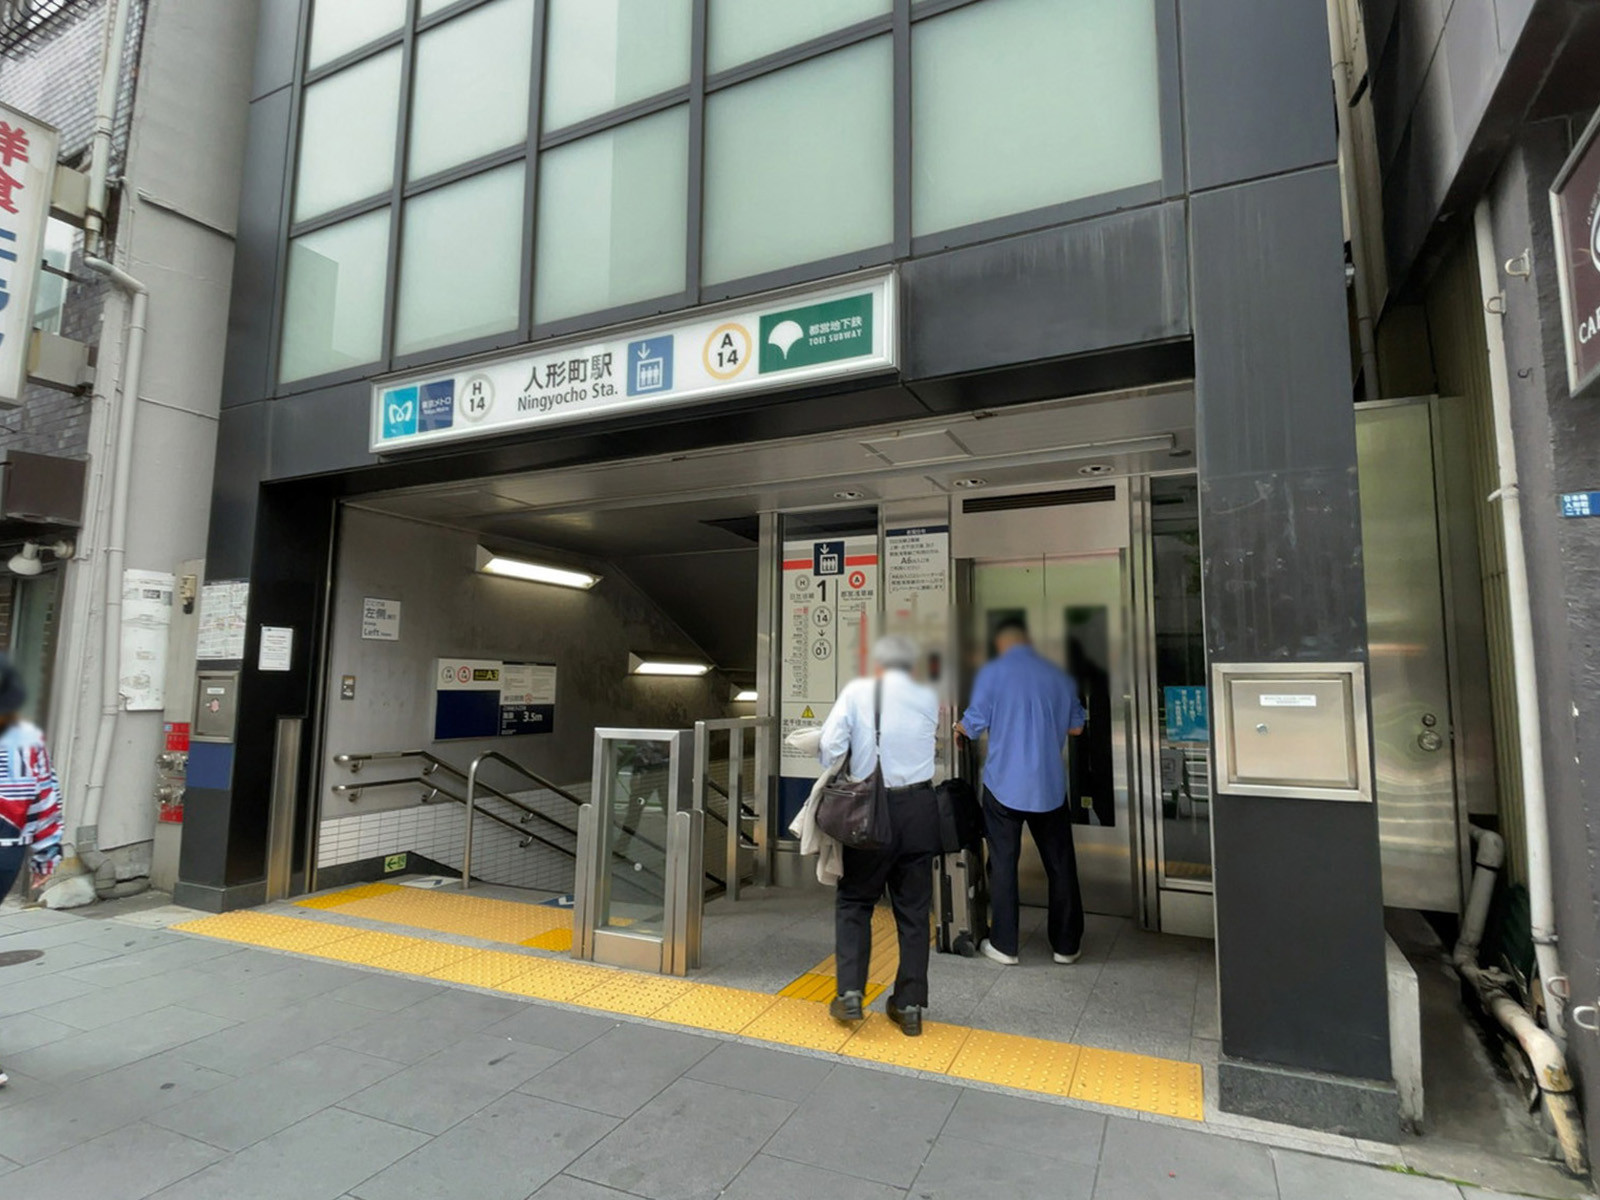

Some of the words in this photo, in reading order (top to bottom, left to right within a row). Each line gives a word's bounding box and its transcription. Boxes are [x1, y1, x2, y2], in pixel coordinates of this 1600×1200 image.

[808, 316, 863, 336] 都営地下鉄
[721, 333, 734, 349] A
[808, 336, 827, 346] TOEI
[828, 329, 863, 342] SUBWAY
[718, 349, 739, 367] 14
[523, 353, 613, 392] 人形町駅
[472, 382, 482, 395] H
[518, 385, 587, 412] Ningyocho
[592, 381, 618, 398] Sta.
[469, 396, 485, 412] 14
[817, 580, 826, 602] 1
[817, 614, 828, 622] 14
[815, 647, 827, 656] 01
